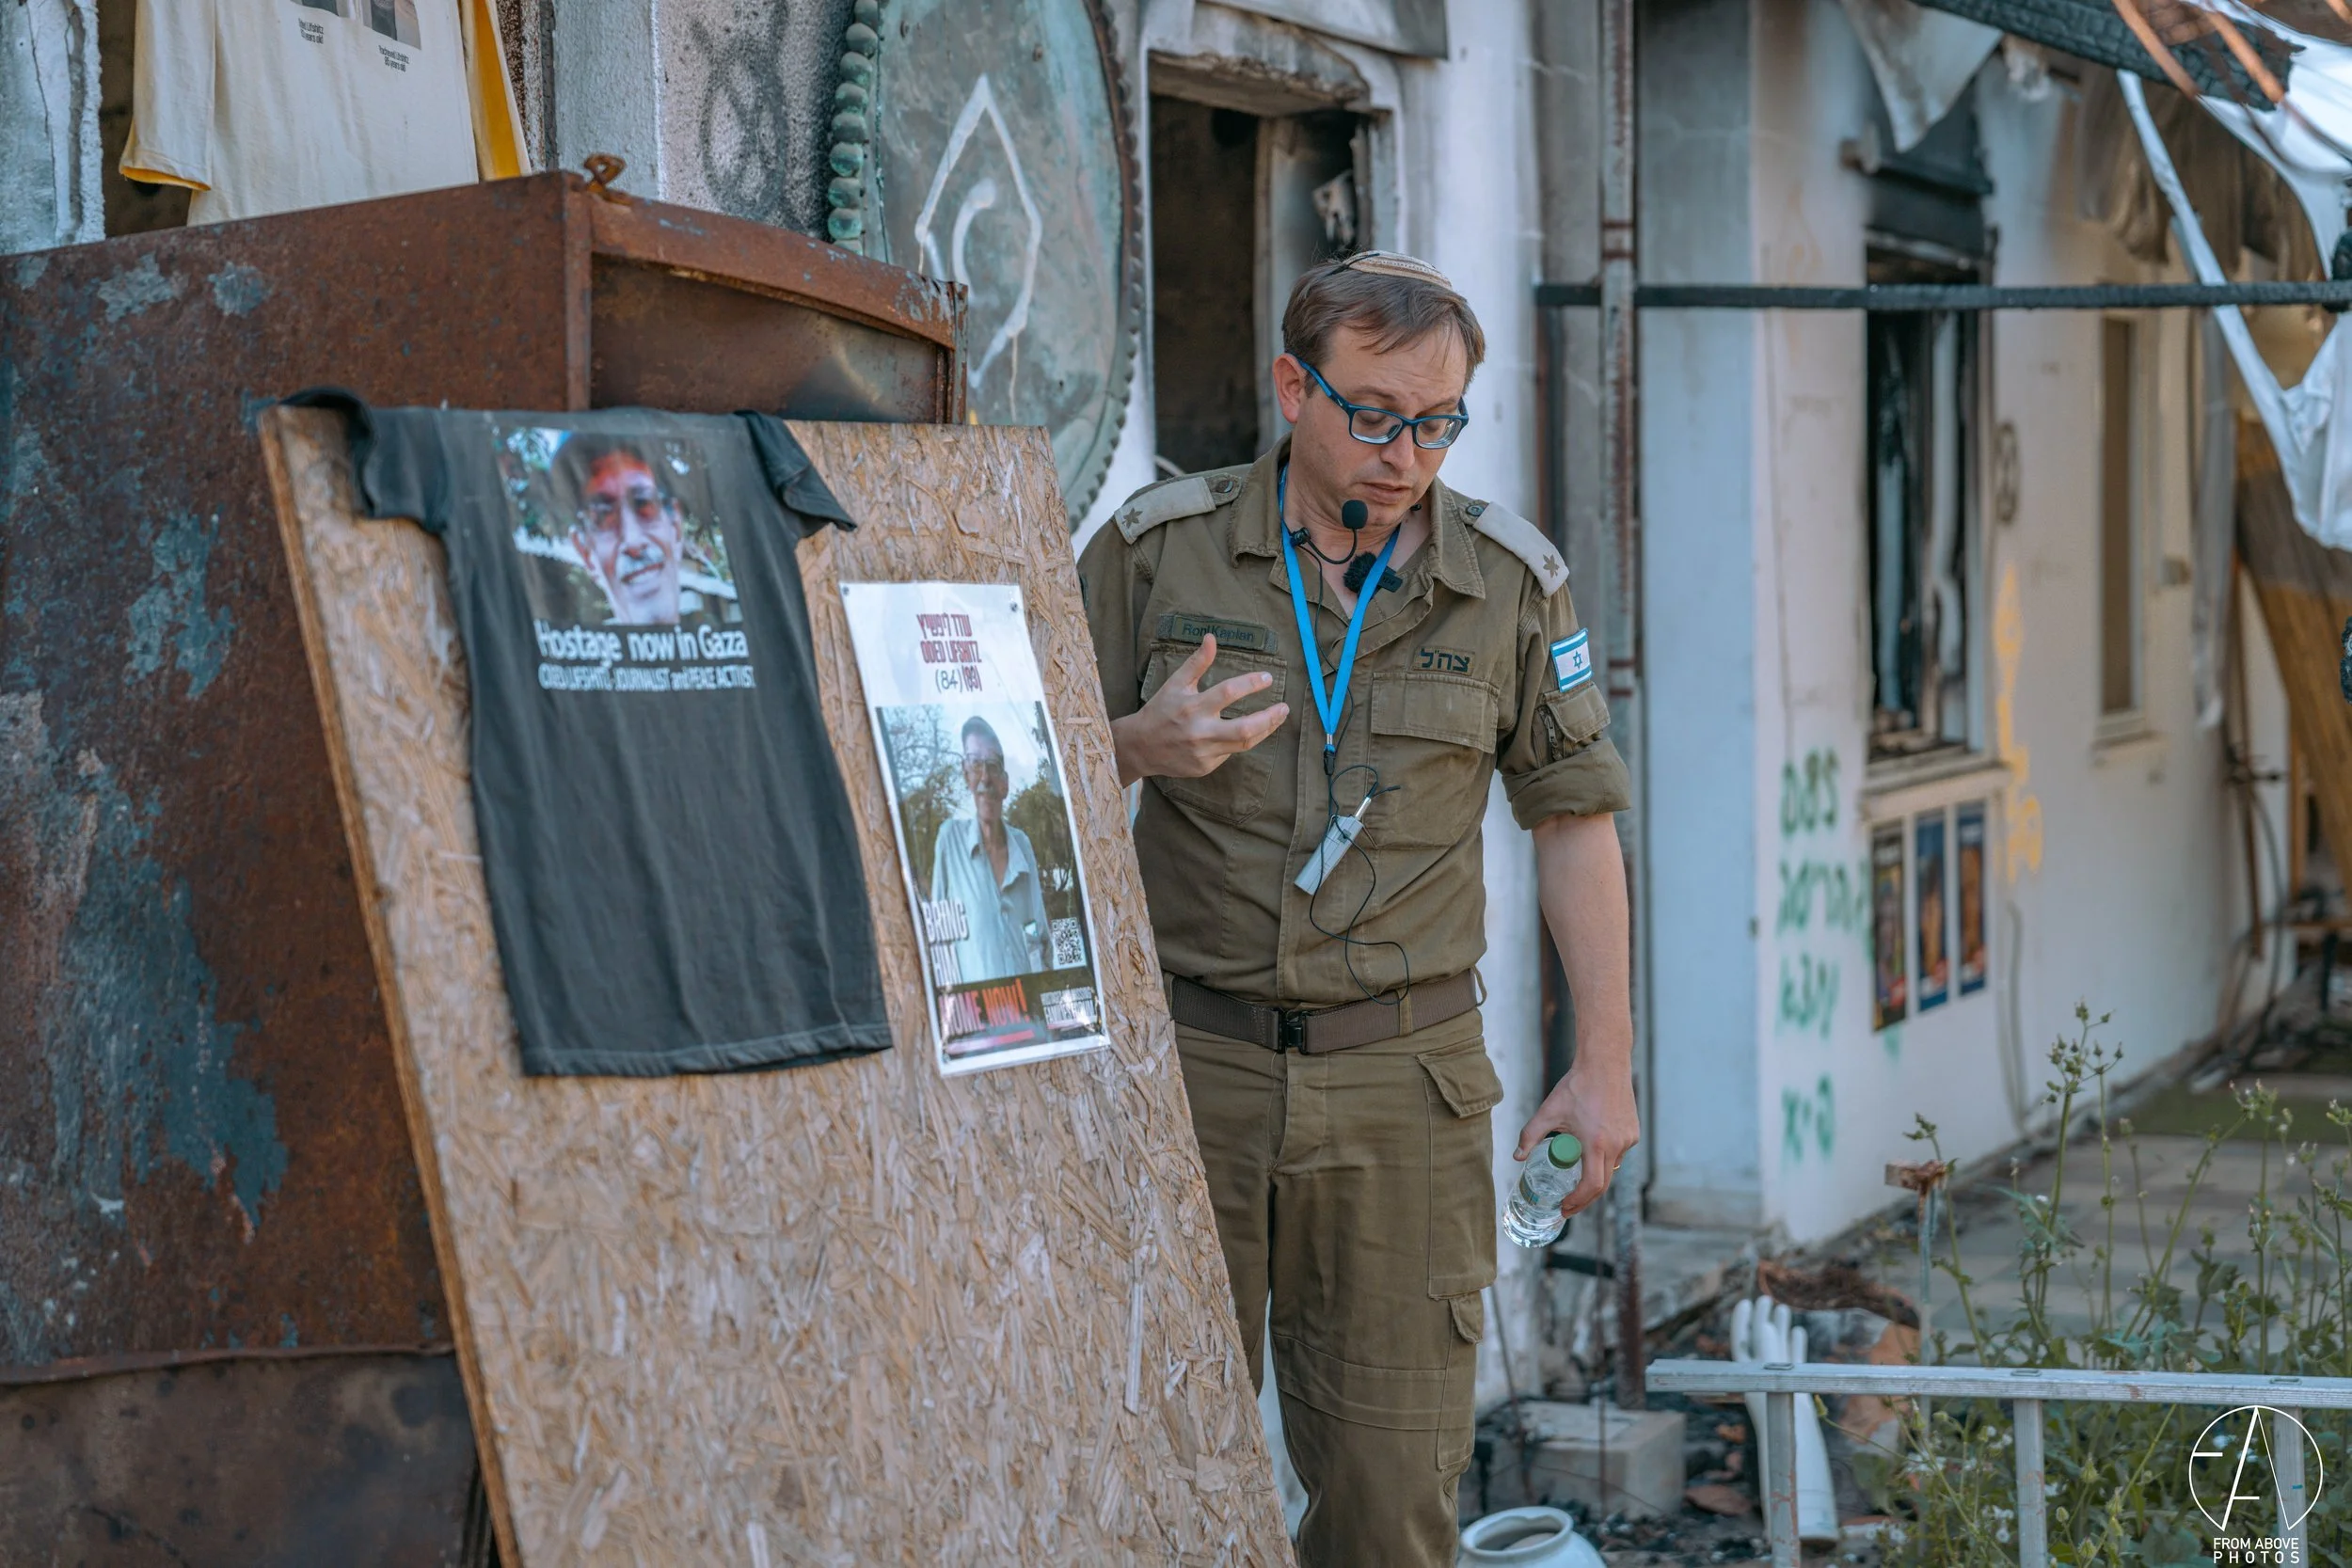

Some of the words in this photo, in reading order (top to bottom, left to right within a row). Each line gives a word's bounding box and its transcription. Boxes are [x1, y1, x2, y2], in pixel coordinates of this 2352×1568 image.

[533, 618, 623, 669] Hostage
[628, 631, 675, 661] now
[675, 625, 699, 660] in
[698, 625, 749, 657] Gaza
[1212, 625, 1254, 642] Kaplan
[935, 669, 963, 694] (84)
[1420, 646, 1470, 673] צה"ל
[921, 897, 970, 943] BRING
[930, 941, 964, 988] HIM
[938, 990, 986, 1037] HOME
[982, 977, 1031, 1028] NOW!
